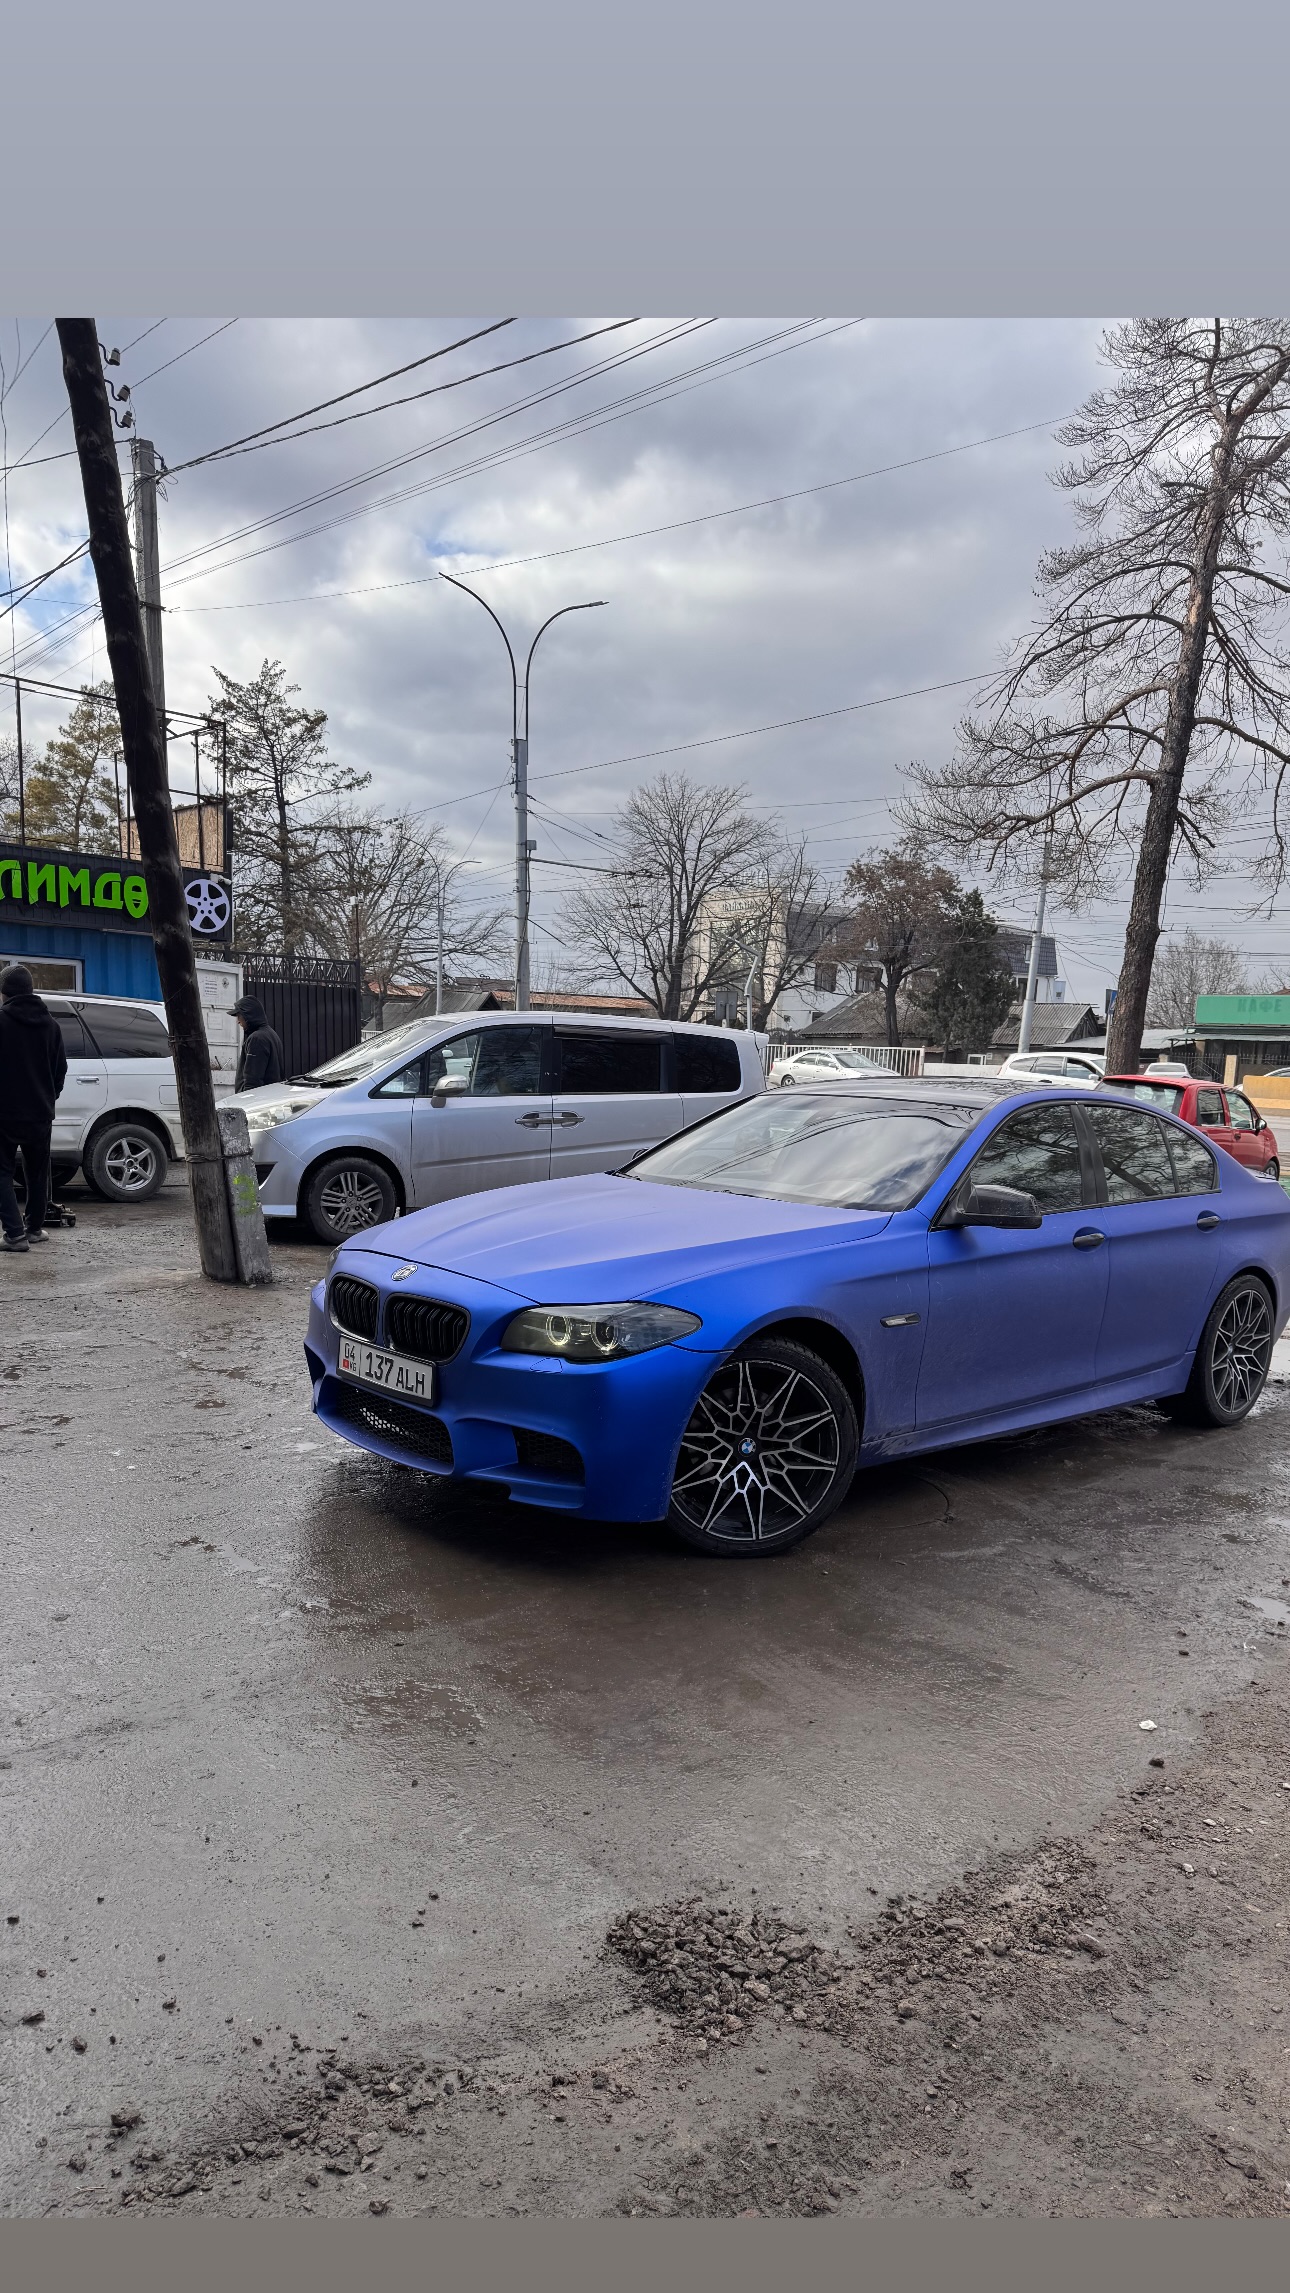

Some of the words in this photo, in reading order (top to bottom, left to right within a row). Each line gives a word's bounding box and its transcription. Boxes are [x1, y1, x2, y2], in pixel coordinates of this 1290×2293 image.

[344, 1343, 356, 1361] 04
[365, 1352, 394, 1384] 137
[396, 1367, 426, 1395] ALH
